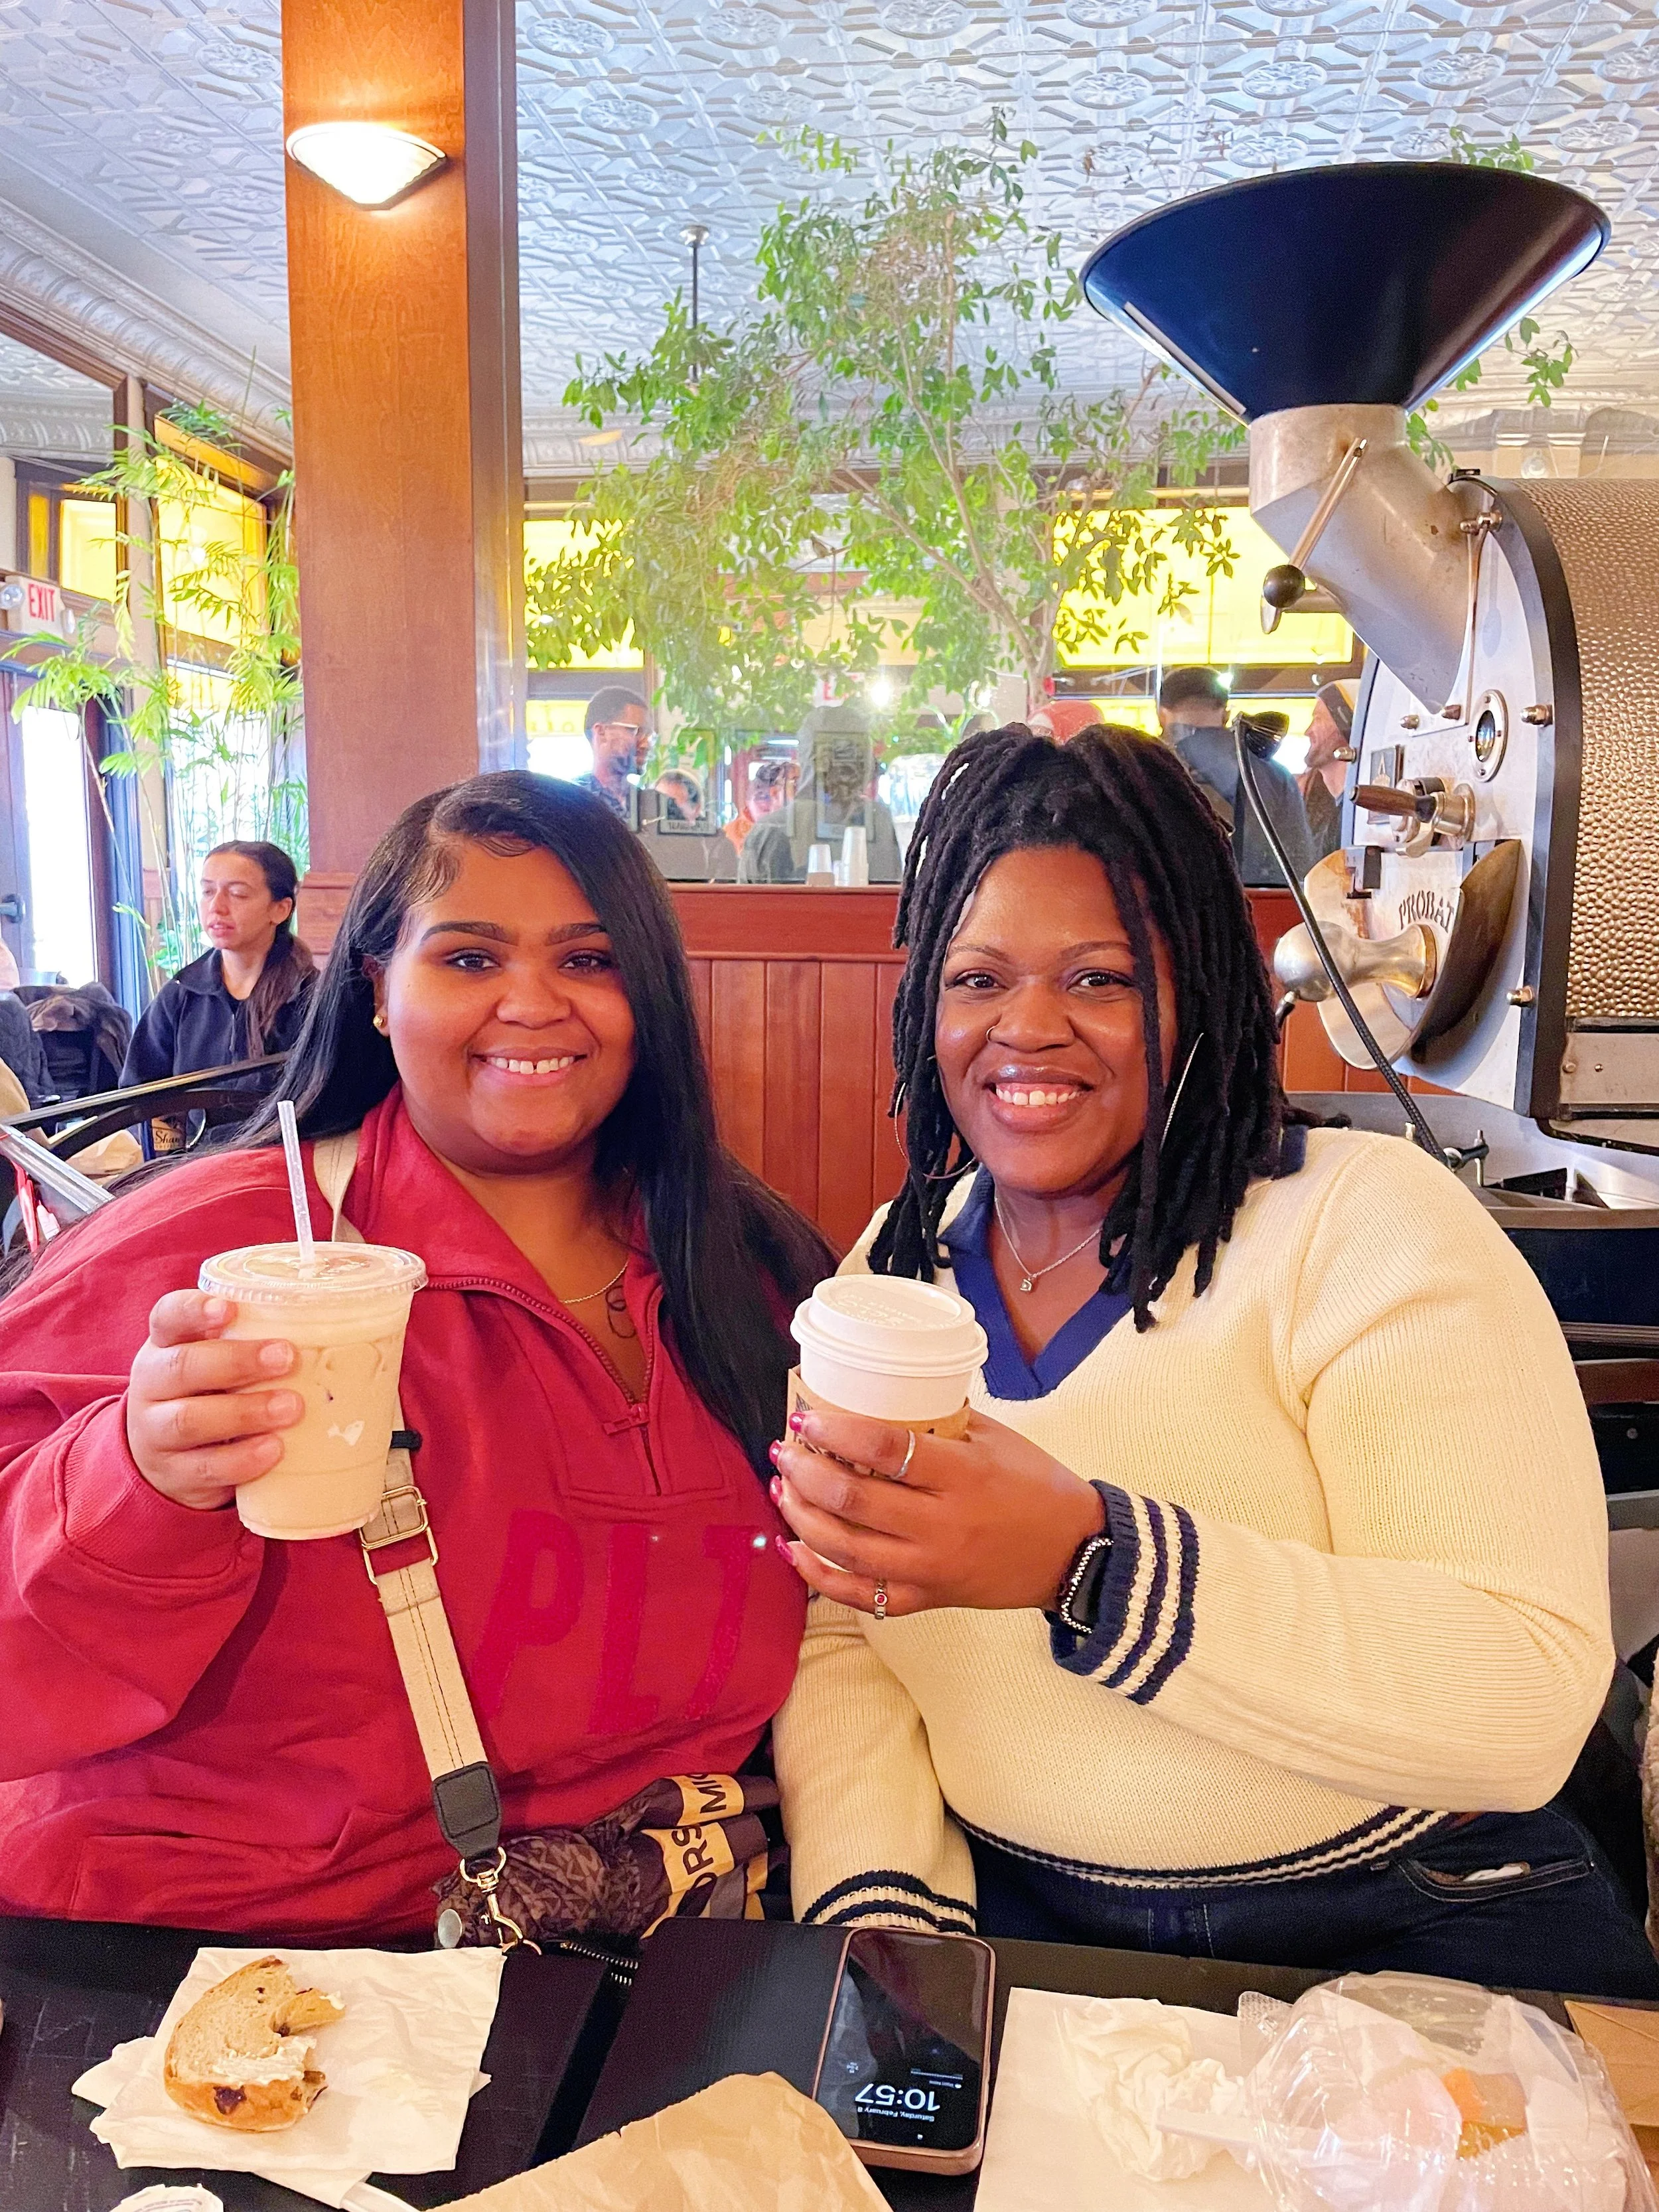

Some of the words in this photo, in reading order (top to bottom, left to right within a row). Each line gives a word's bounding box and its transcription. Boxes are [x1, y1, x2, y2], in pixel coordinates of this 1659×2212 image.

[28, 583, 55, 622] EXIT
[1399, 890, 1455, 933] PROBAT
[855, 2083, 940, 2111] 10:57
[864, 2107, 899, 2117] February
[899, 2111, 935, 2122] Saturday,
